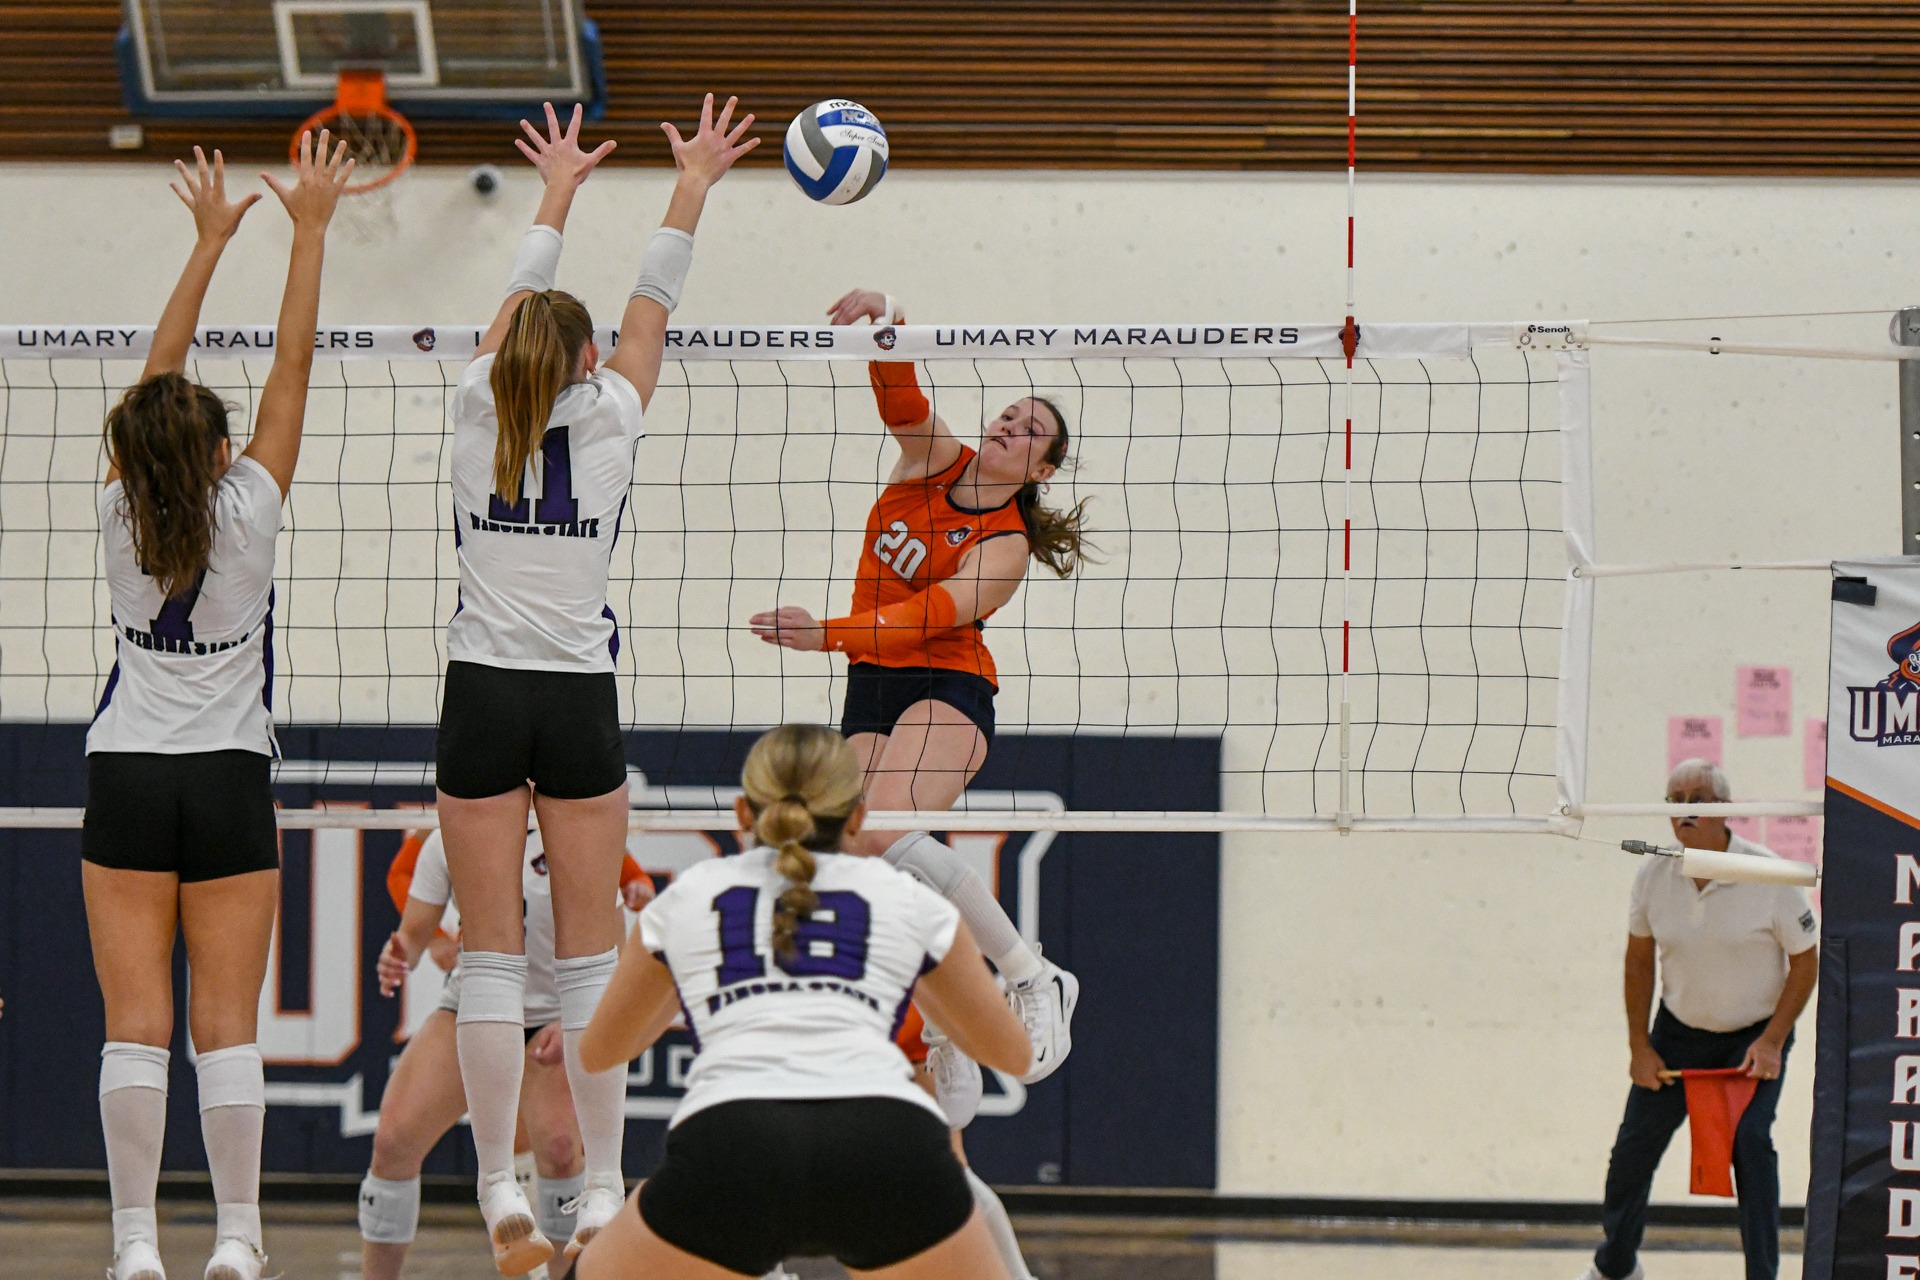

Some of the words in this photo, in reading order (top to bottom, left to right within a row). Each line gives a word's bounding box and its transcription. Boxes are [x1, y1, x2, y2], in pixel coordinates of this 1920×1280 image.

[18, 329, 137, 347] UMARY
[153, 330, 374, 348] RAUERS
[936, 328, 1058, 346] UMARY
[1074, 327, 1299, 346] MARAUDERS
[1537, 325, 1570, 333] Senoh
[612, 330, 834, 348] RAUDERS
[873, 520, 927, 582] 20
[711, 885, 871, 987] 18
